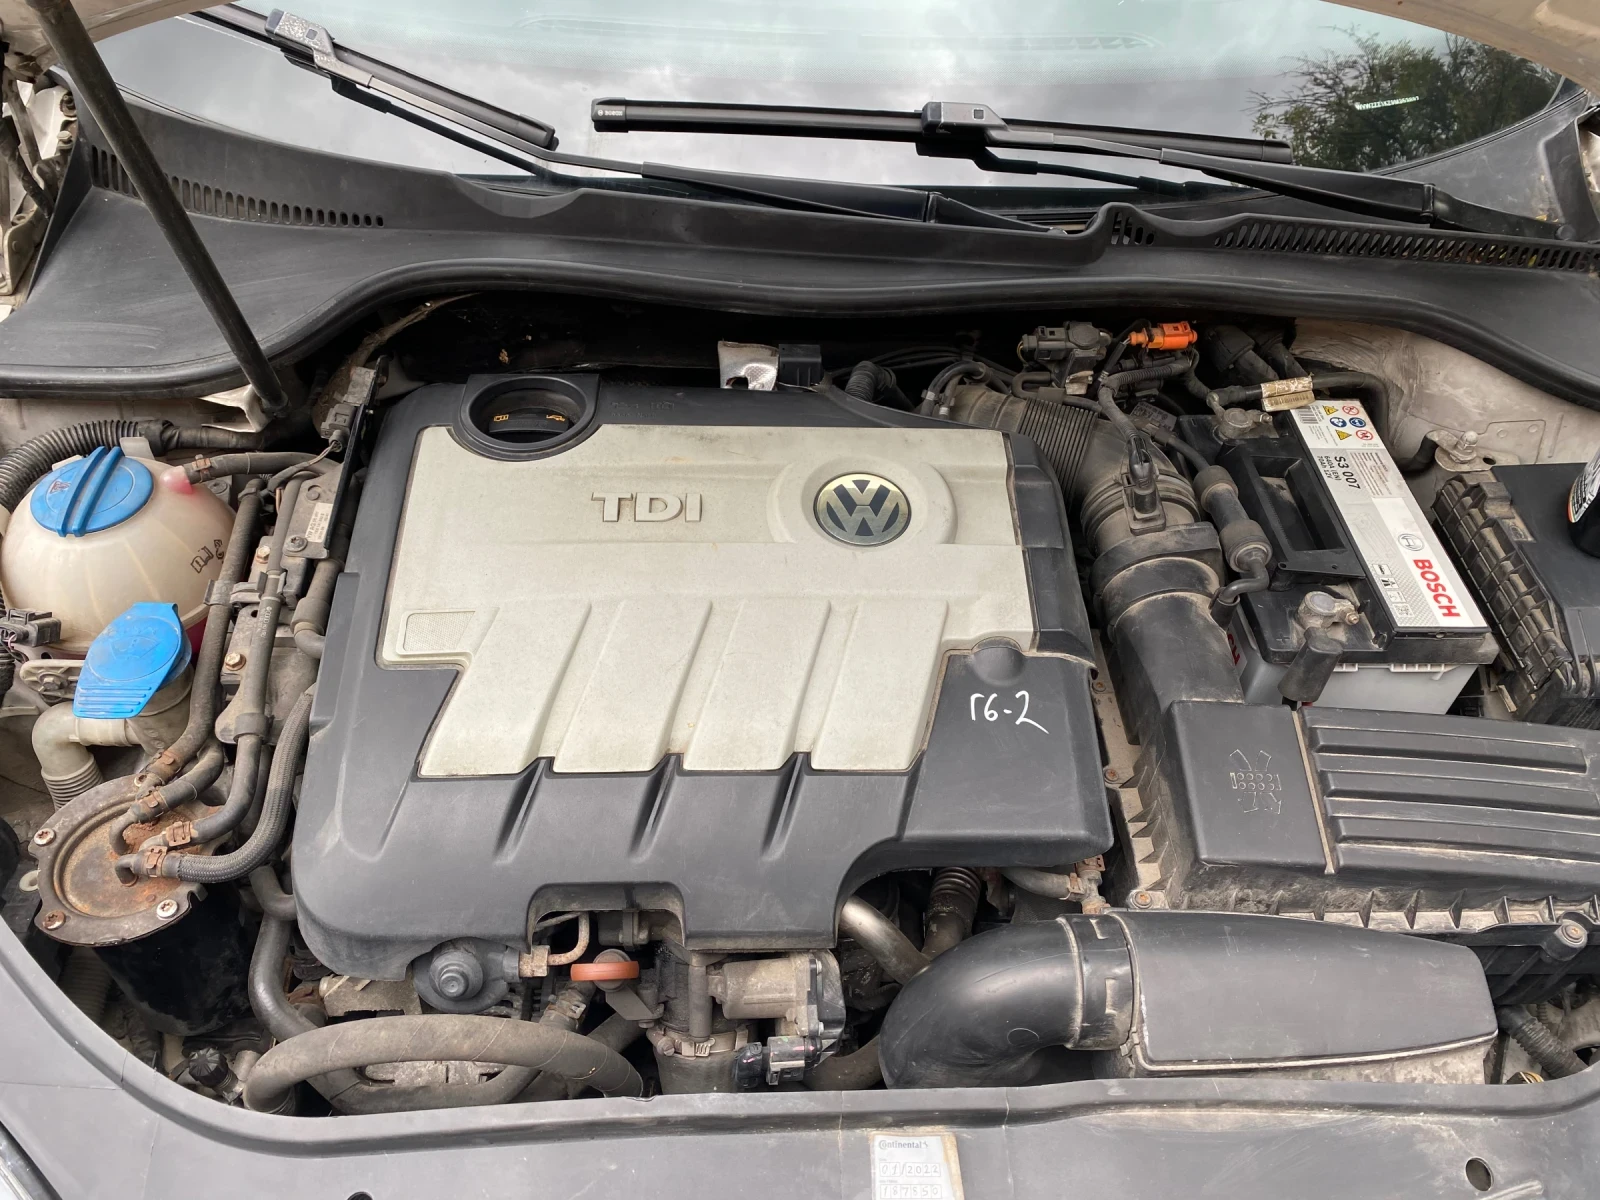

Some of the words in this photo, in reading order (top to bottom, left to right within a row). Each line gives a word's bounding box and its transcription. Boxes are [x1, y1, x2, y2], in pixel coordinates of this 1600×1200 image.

[1334, 456, 1350, 469] S3
[1342, 471, 1361, 490] 007
[591, 491, 703, 523] TDI
[814, 473, 911, 546] VW
[1413, 559, 1461, 617] BOSCH
[879, 1139, 922, 1150] Continental
